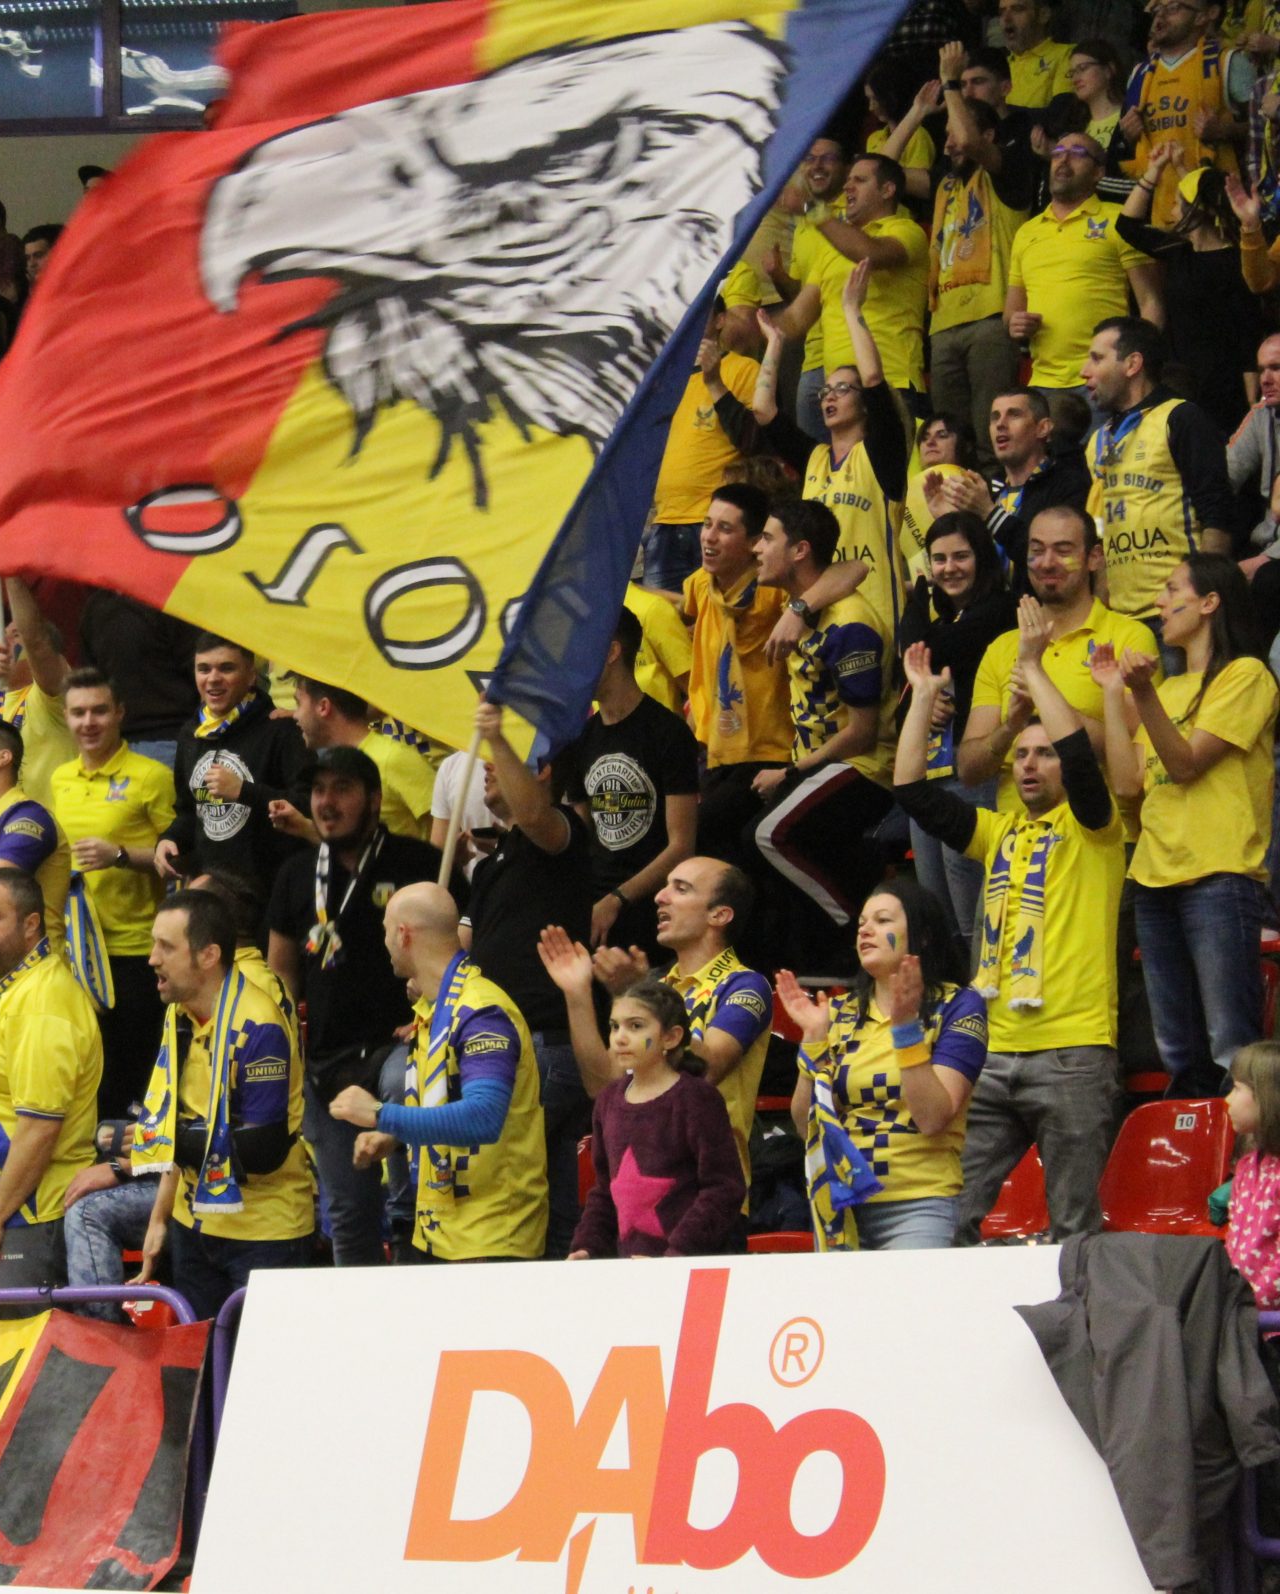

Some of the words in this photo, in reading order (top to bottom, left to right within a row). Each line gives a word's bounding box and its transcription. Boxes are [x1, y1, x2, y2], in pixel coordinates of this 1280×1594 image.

[1145, 96, 1188, 117] CSU
[1149, 115, 1187, 132] SIBIU
[1124, 473, 1164, 493] SIBIU
[833, 492, 873, 512] SIBIU
[1105, 500, 1126, 524] 14
[1107, 527, 1170, 556] AQUA
[602, 779, 621, 792] 1918
[603, 812, 623, 825] 2018
[464, 1040, 508, 1054] UNIMAT
[246, 1064, 287, 1077] UNIMAT
[1178, 1116, 1194, 1128] 10
[403, 1268, 887, 1579] DAbo
